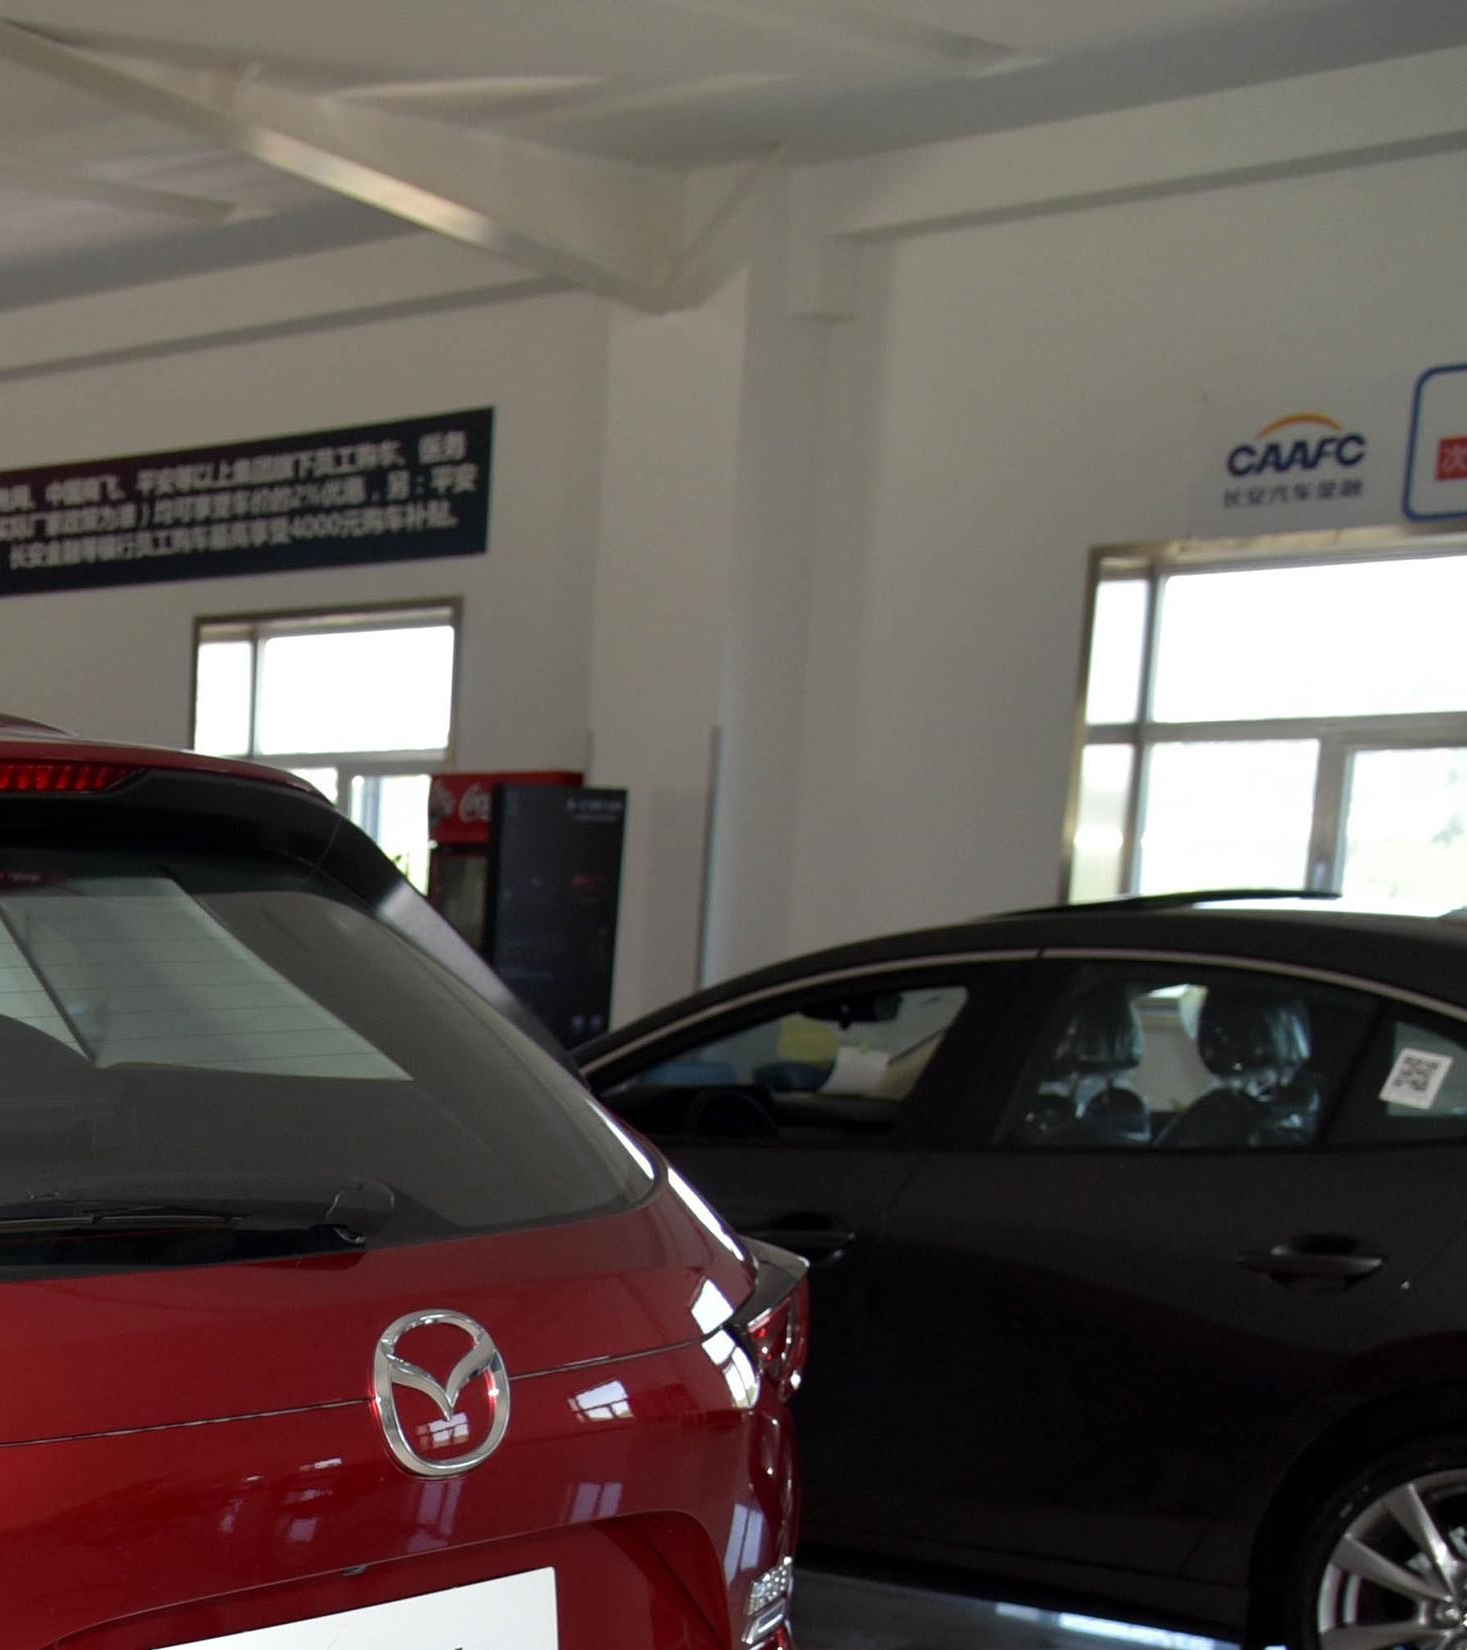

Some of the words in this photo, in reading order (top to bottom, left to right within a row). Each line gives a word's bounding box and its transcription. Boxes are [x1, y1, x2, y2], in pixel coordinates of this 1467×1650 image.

[1226, 433, 1366, 478] CAAFC
[1222, 479, 1364, 509] 长安汽车金融
